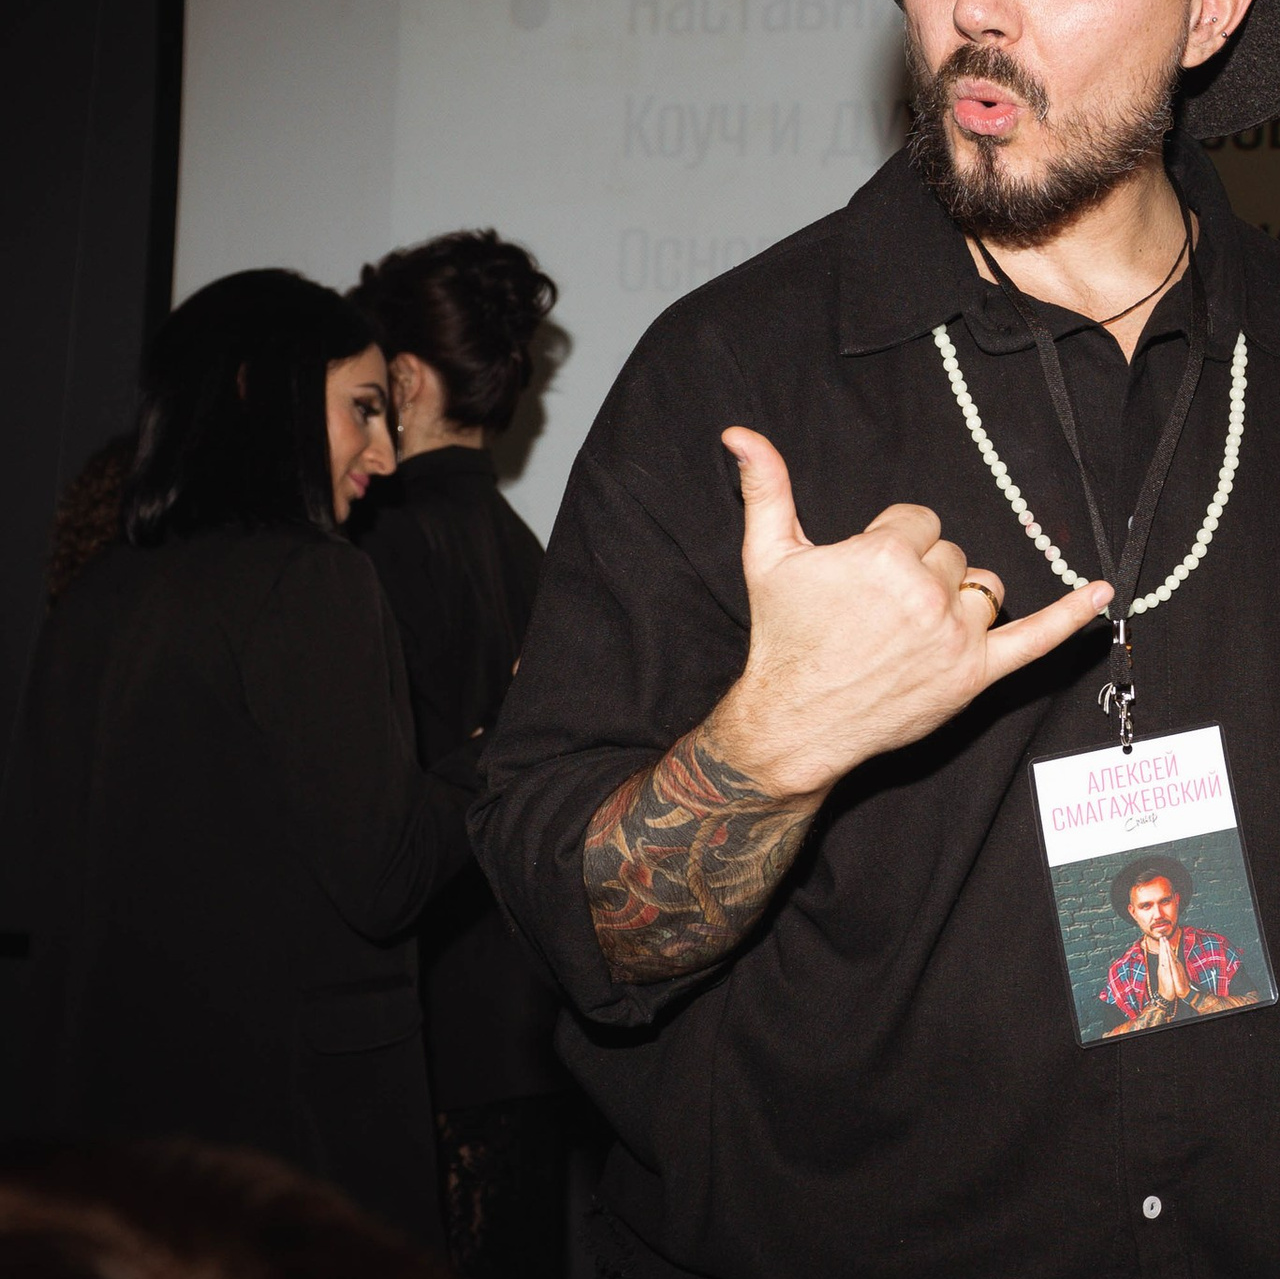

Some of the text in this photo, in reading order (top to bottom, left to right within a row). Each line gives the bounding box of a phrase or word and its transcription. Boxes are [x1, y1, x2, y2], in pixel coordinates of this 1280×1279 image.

[621, 95, 750, 170] Коуч
[770, 101, 802, 157] и
[1051, 769, 1223, 832] СМАГАЖЕВСКИЙ
[1087, 749, 1180, 795] АЛЕКСЕЙ
